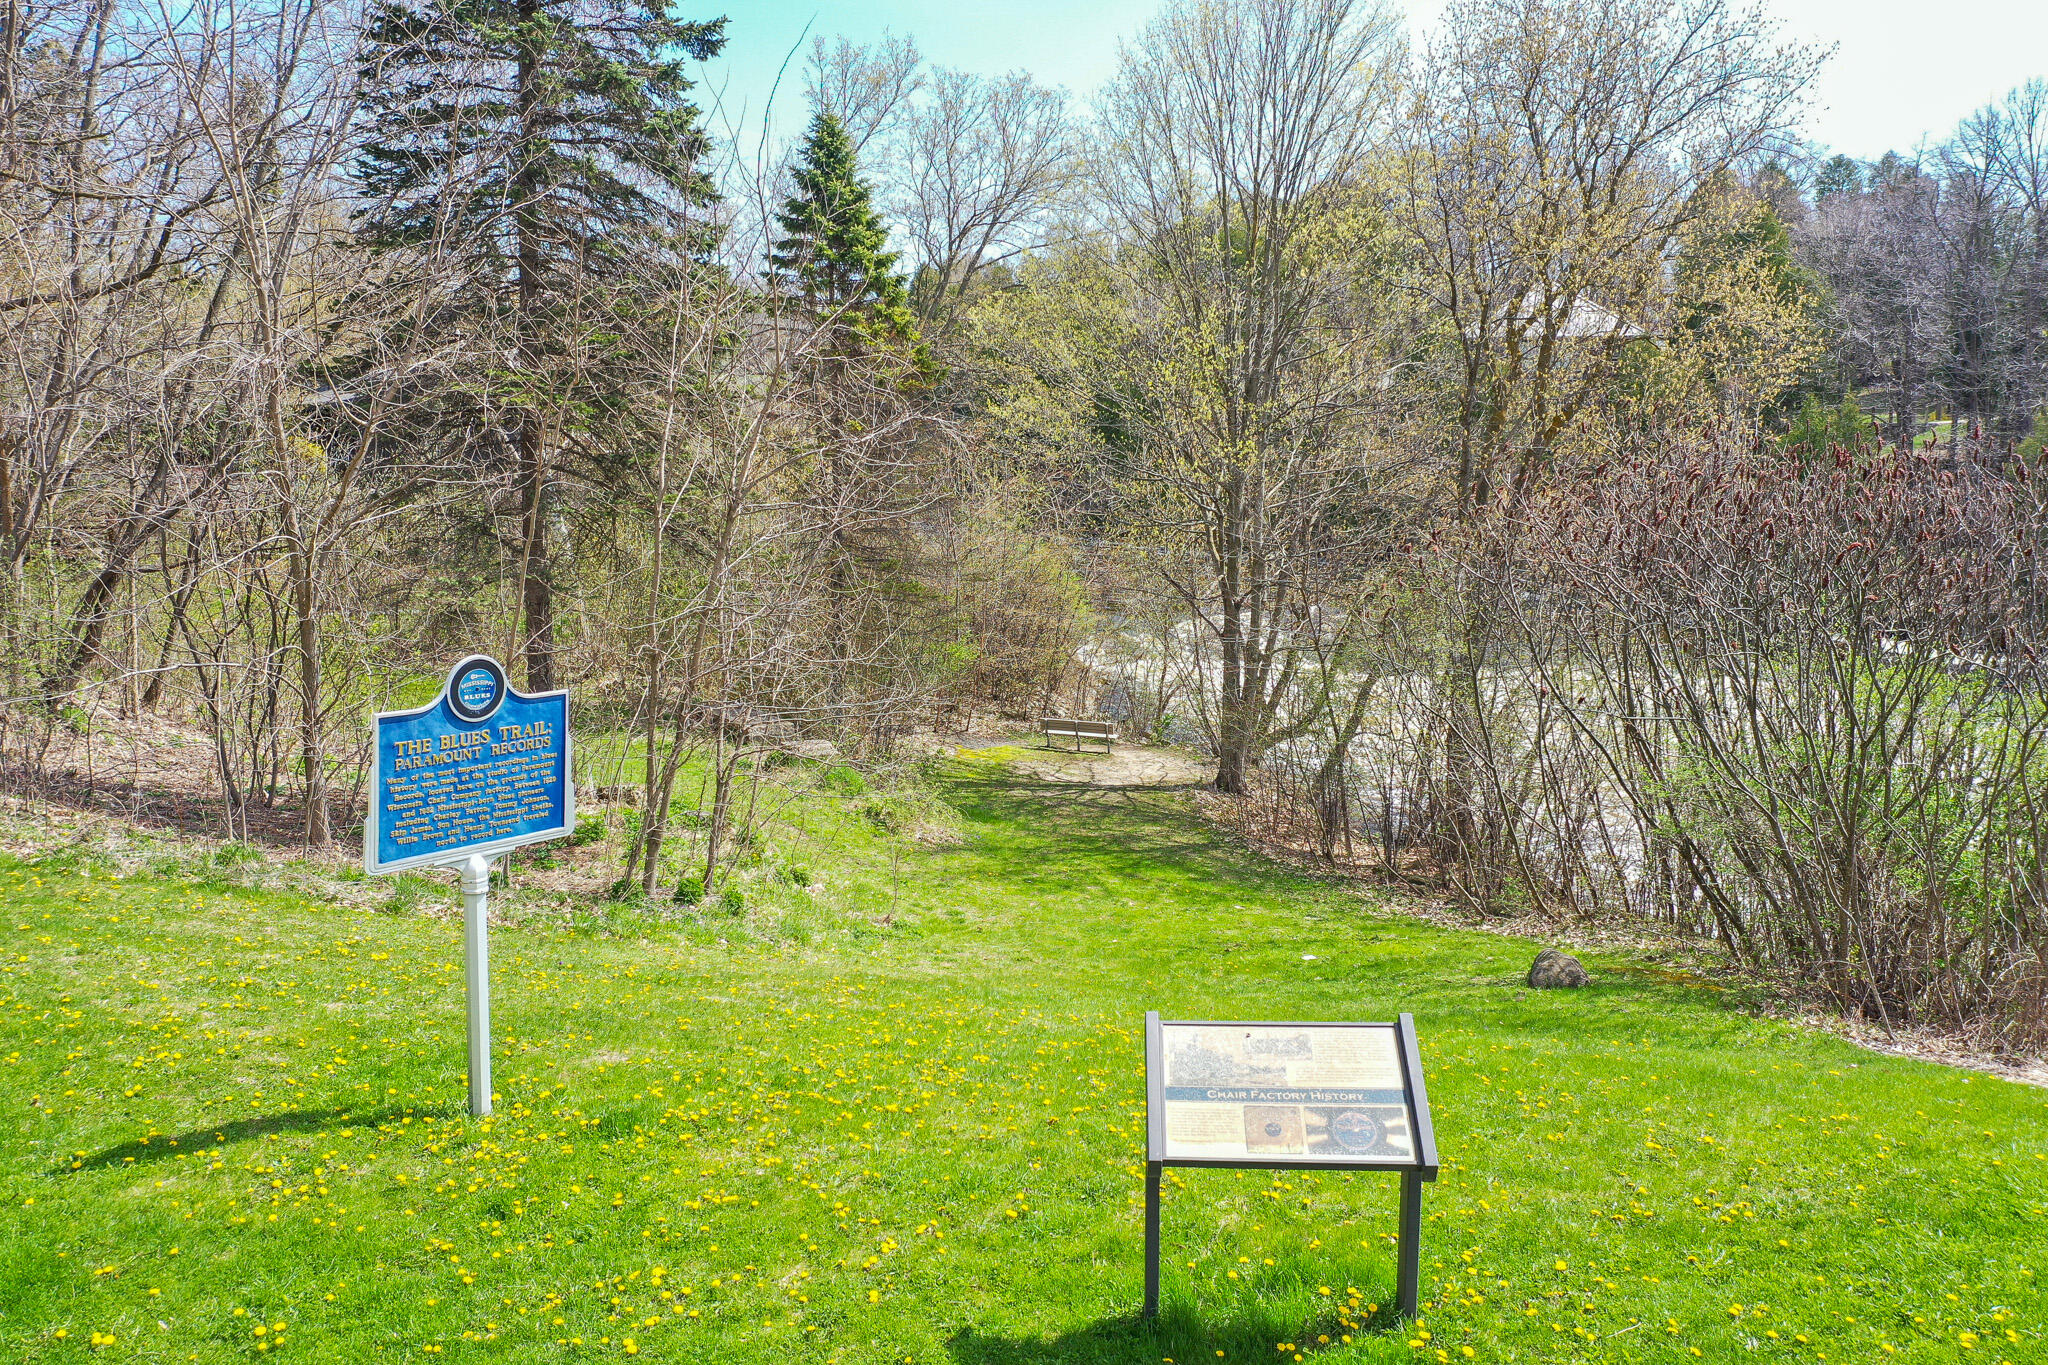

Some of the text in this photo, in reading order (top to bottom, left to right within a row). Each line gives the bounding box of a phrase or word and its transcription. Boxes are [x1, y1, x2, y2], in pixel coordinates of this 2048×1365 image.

[394, 721, 553, 756] THE BLUES TRAIL:
[395, 736, 552, 772] PARAMOUNT RECORDS
[1206, 1089, 1247, 1099] CHAIR
[1250, 1090, 1307, 1100] FACTORY
